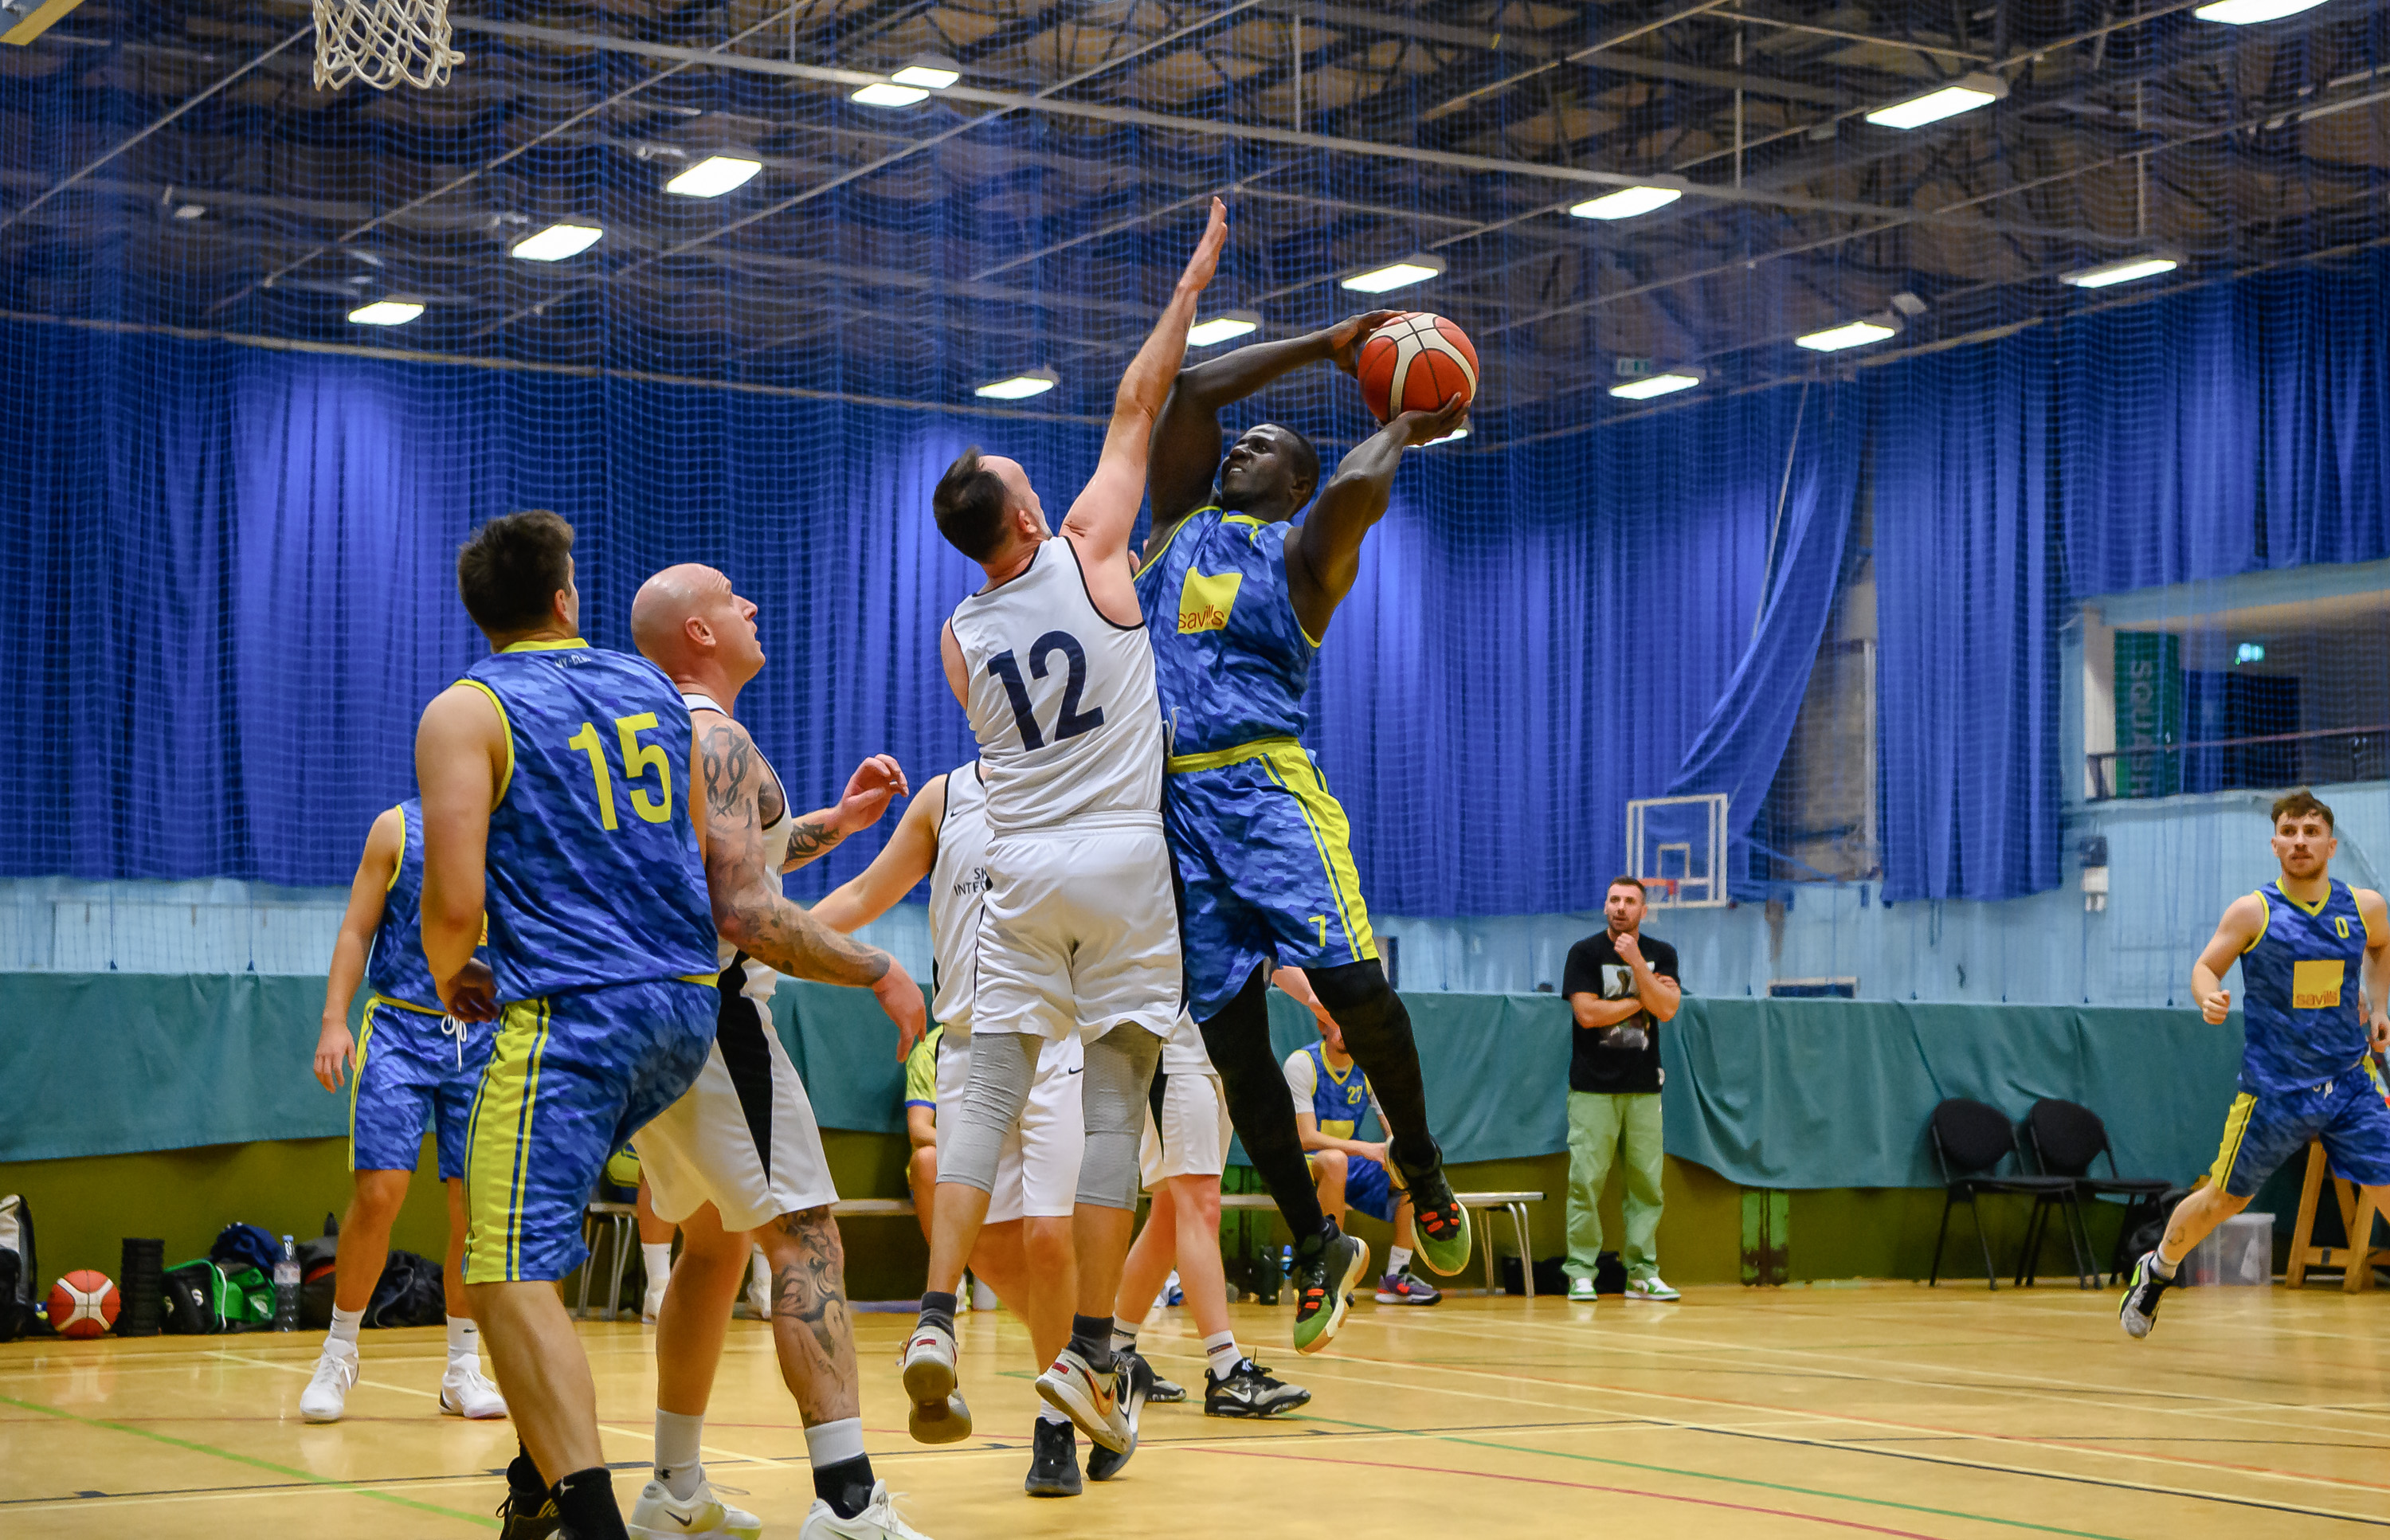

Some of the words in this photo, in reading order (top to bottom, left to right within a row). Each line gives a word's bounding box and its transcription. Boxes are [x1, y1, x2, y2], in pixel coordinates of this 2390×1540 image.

[1178, 604, 1224, 629] savills
[987, 630, 1105, 752] 12
[2129, 659, 2154, 796] SQUASH
[568, 711, 672, 830] 15
[1308, 914, 1326, 947] 7
[2296, 990, 2338, 1005] savills
[1346, 1085, 1363, 1105] 27
